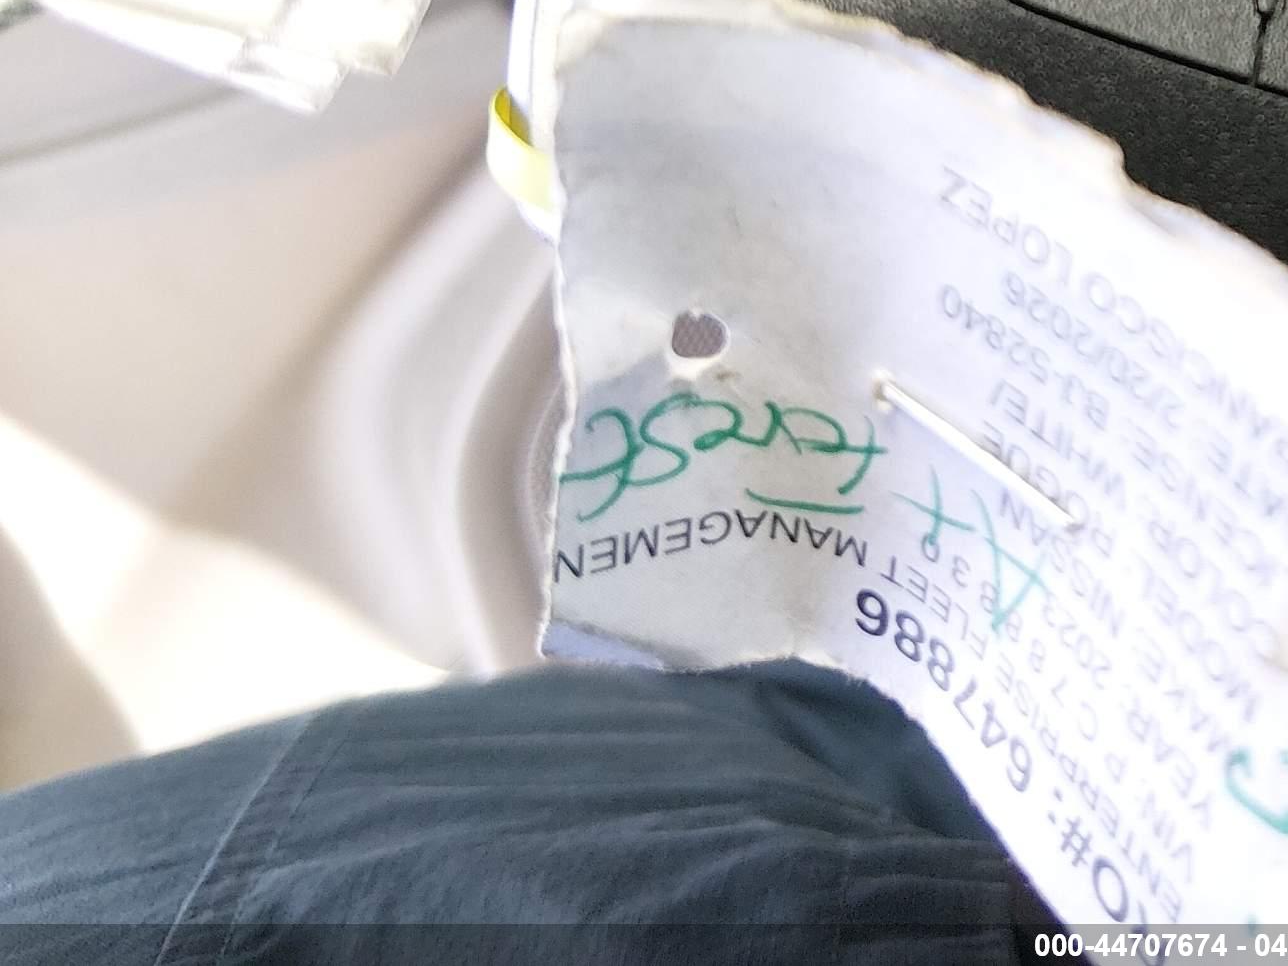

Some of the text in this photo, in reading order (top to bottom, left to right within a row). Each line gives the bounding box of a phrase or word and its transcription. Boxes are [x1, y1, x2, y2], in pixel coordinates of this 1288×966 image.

[933, 166, 1073, 286] LOPEZ
[940, 284, 1108, 431] BJ-52840
[1000, 273, 1183, 429] 2/20/2026
[553, 508, 867, 585] MANAGEMEN
[881, 557, 988, 659] FLEET
[998, 492, 1124, 639] NISSAN
[854, 590, 1032, 793] 647886
[1041, 593, 1112, 688] 2023
[996, 653, 1182, 925] ENTERPRISE
